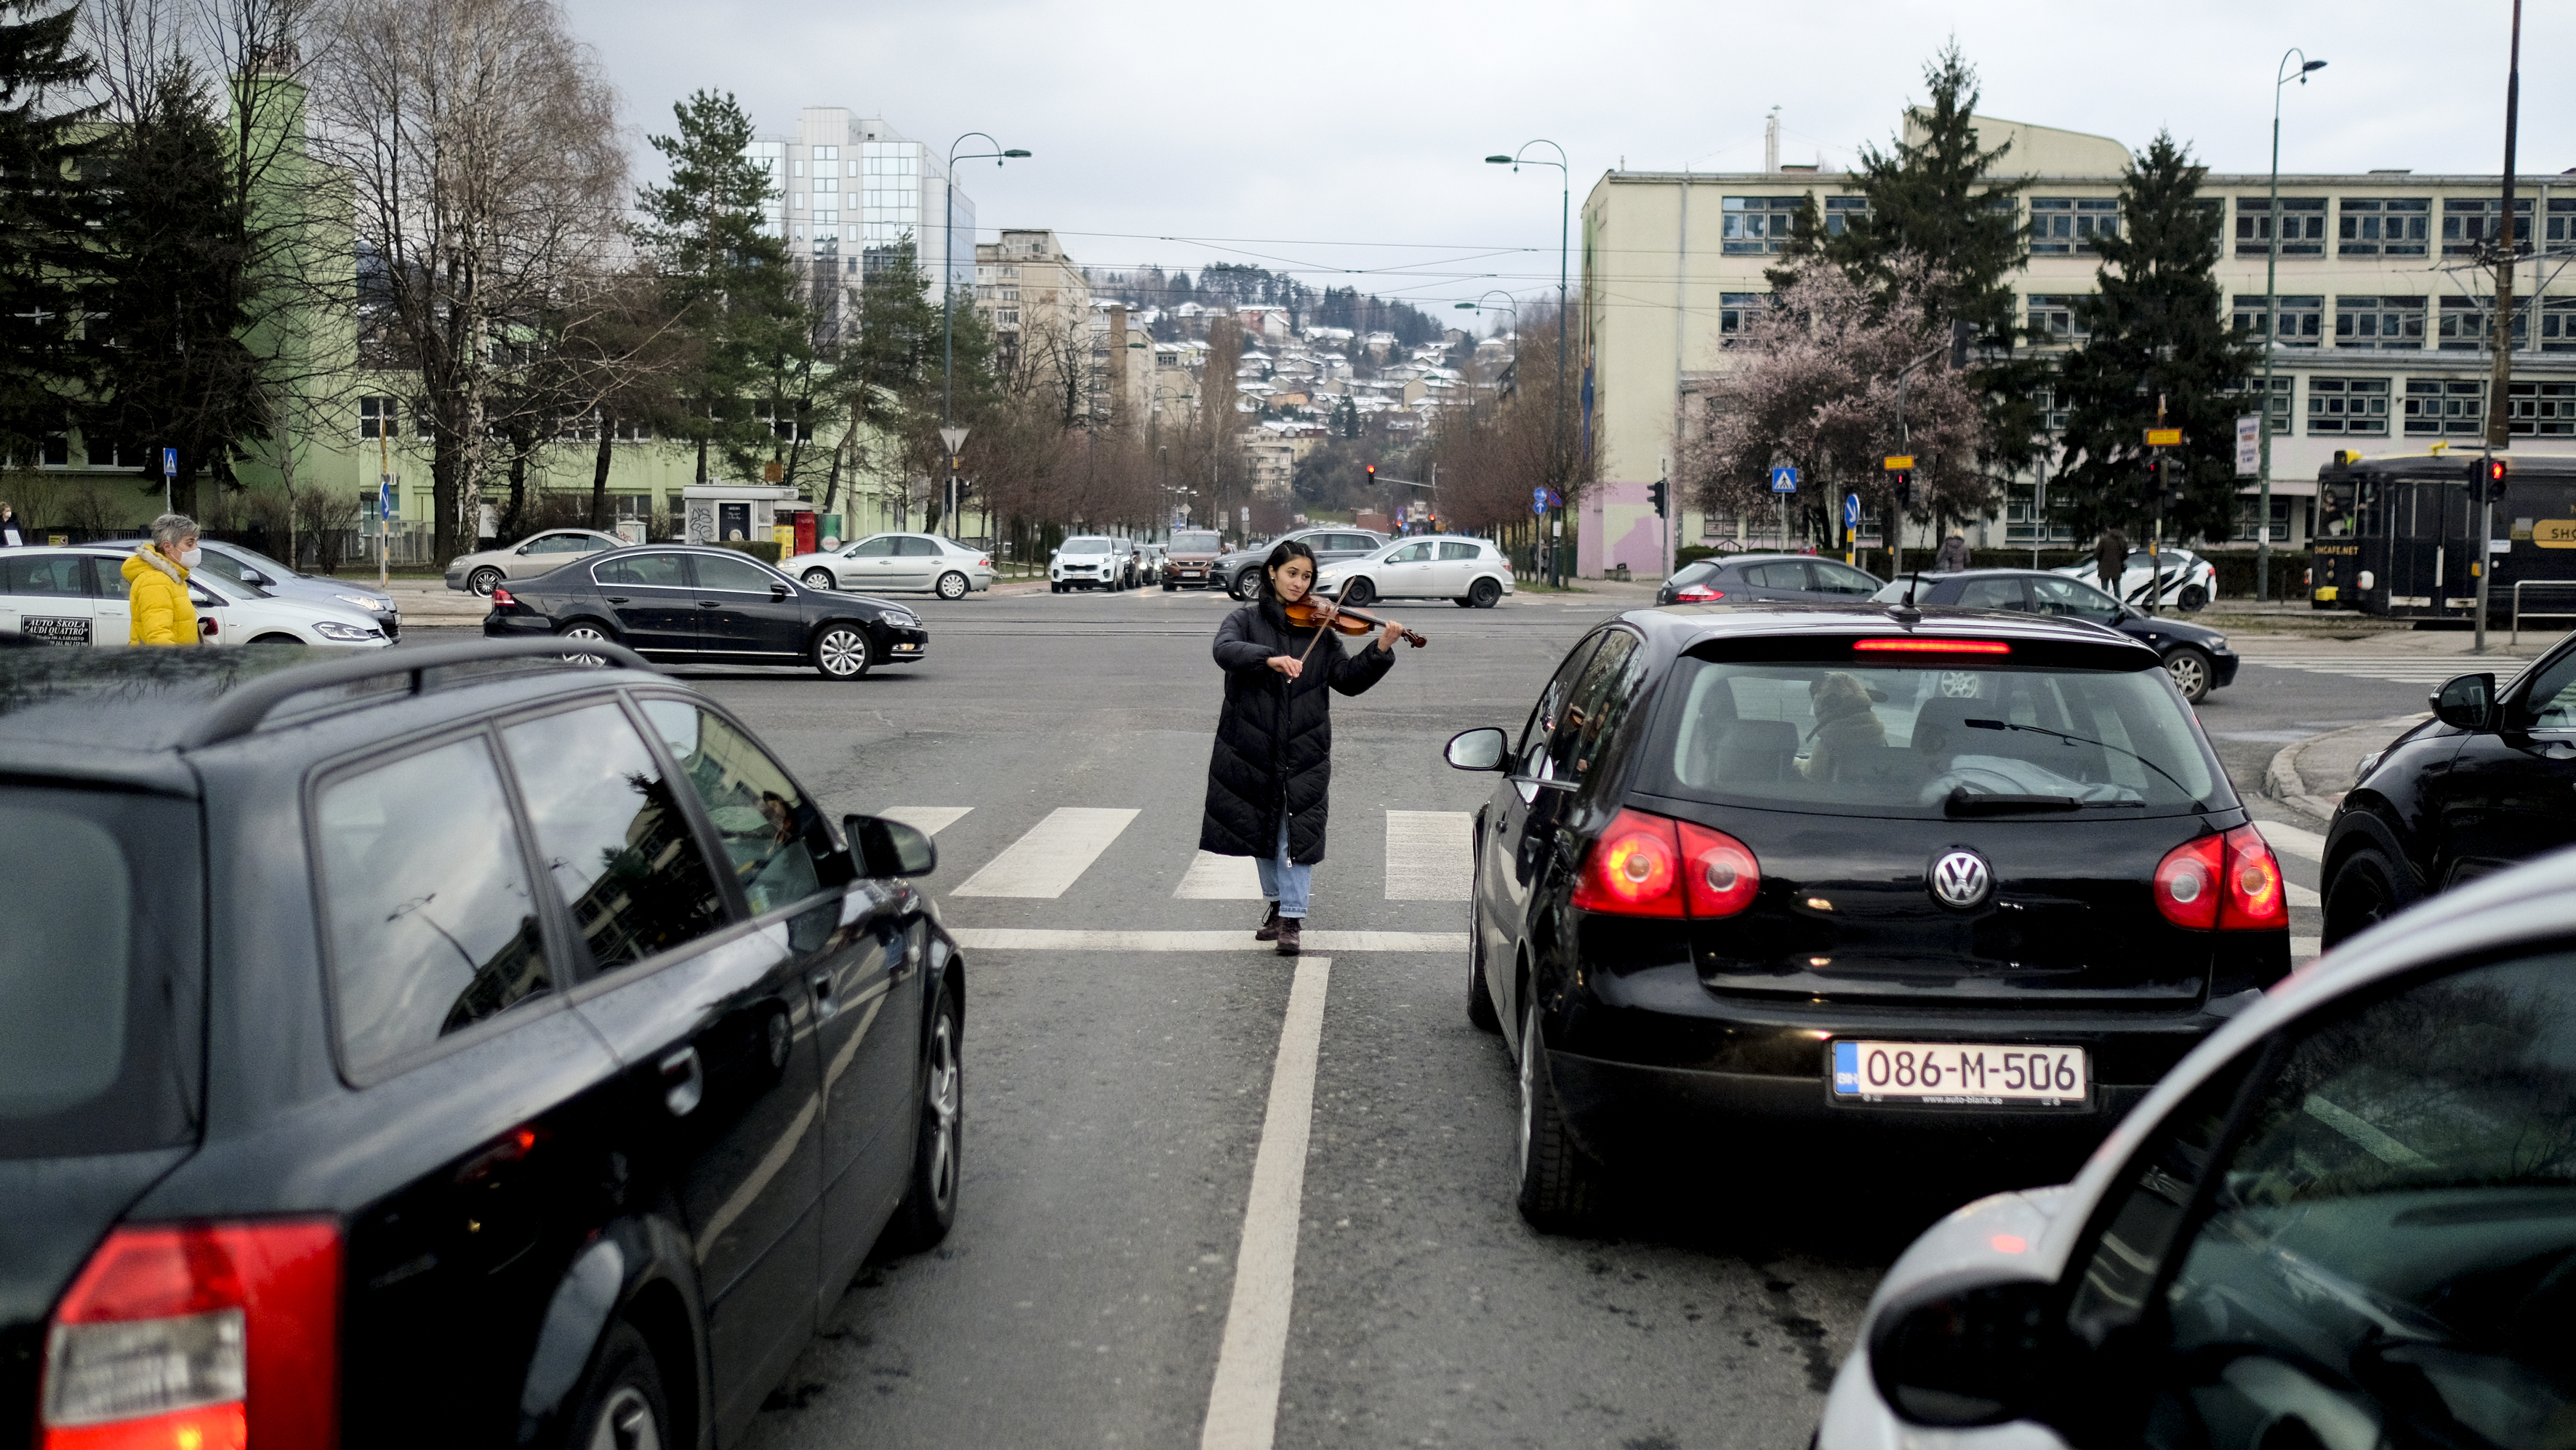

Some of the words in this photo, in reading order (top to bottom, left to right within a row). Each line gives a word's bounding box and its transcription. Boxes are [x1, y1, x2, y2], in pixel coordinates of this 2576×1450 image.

[49, 627, 88, 636] QUATTRO"
[1867, 1049, 2076, 1091] 086-M-506
[1922, 1095, 2003, 1105] www.auto-blank.de
